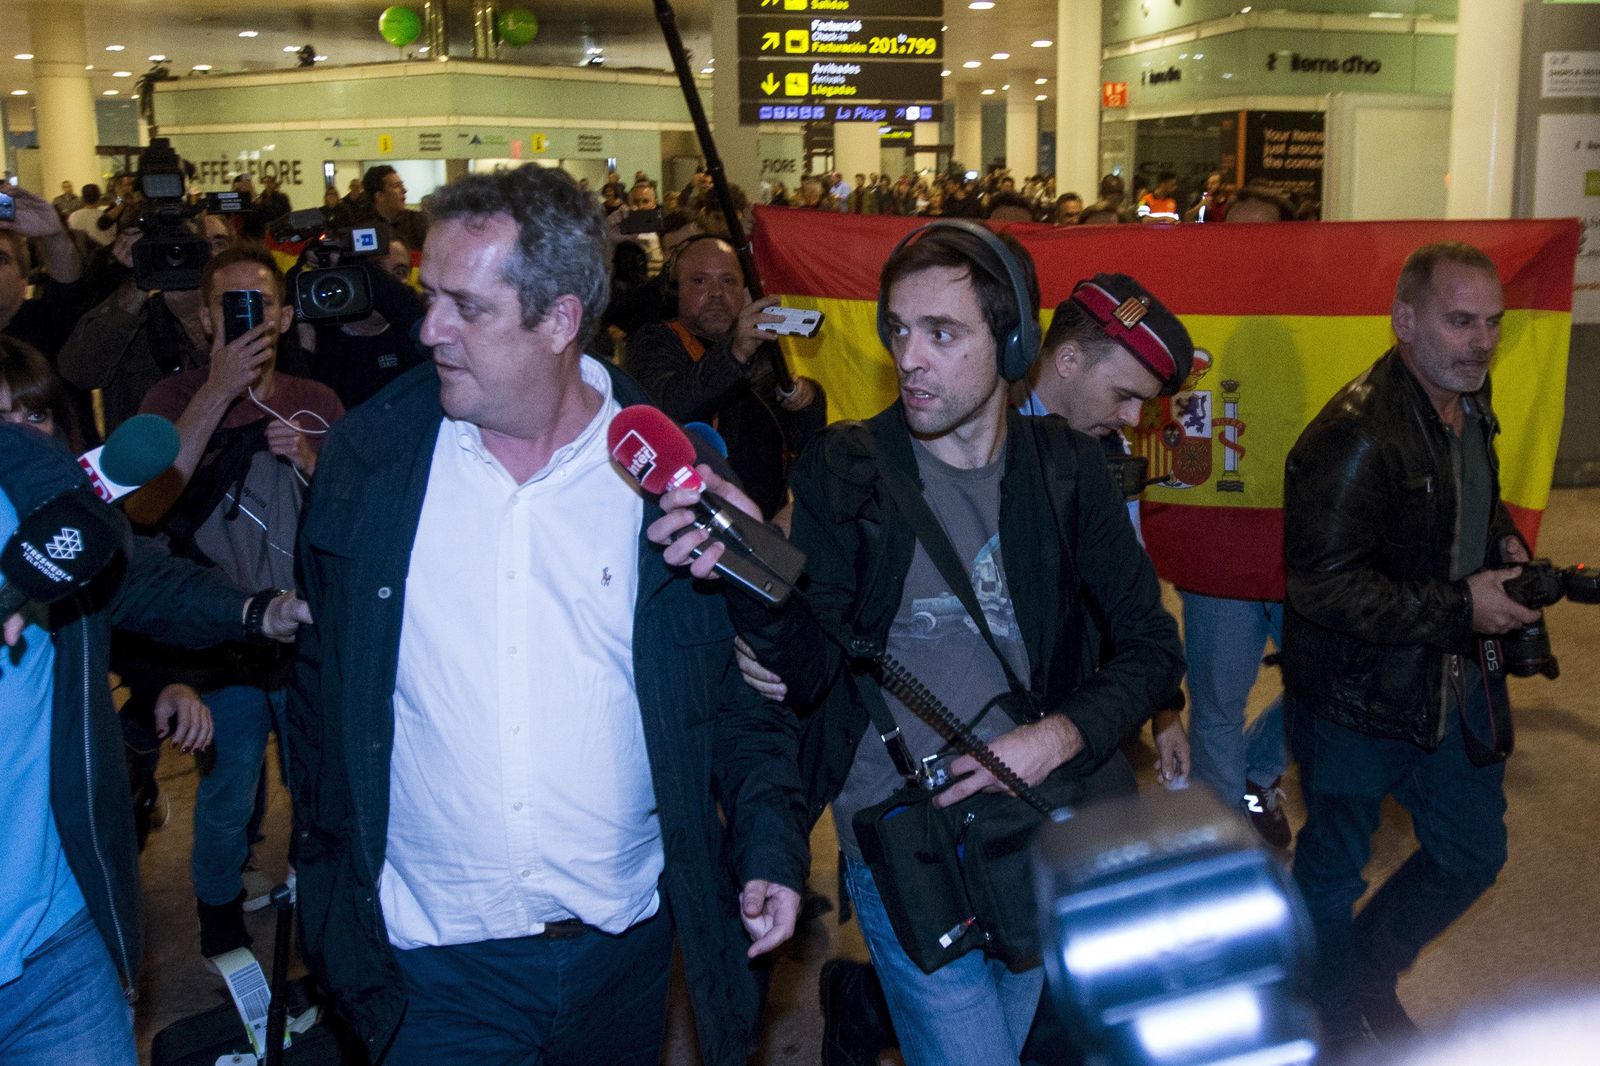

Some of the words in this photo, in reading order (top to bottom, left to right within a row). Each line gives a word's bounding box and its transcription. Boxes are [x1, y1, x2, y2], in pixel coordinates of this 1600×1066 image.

[868, 36, 898, 54] 201
[906, 37, 936, 55] 799
[835, 106, 851, 120] La
[247, 159, 303, 185] FIORE
[20, 541, 73, 583] ATRESMEDIA
[1484, 640, 1499, 672] EOS
